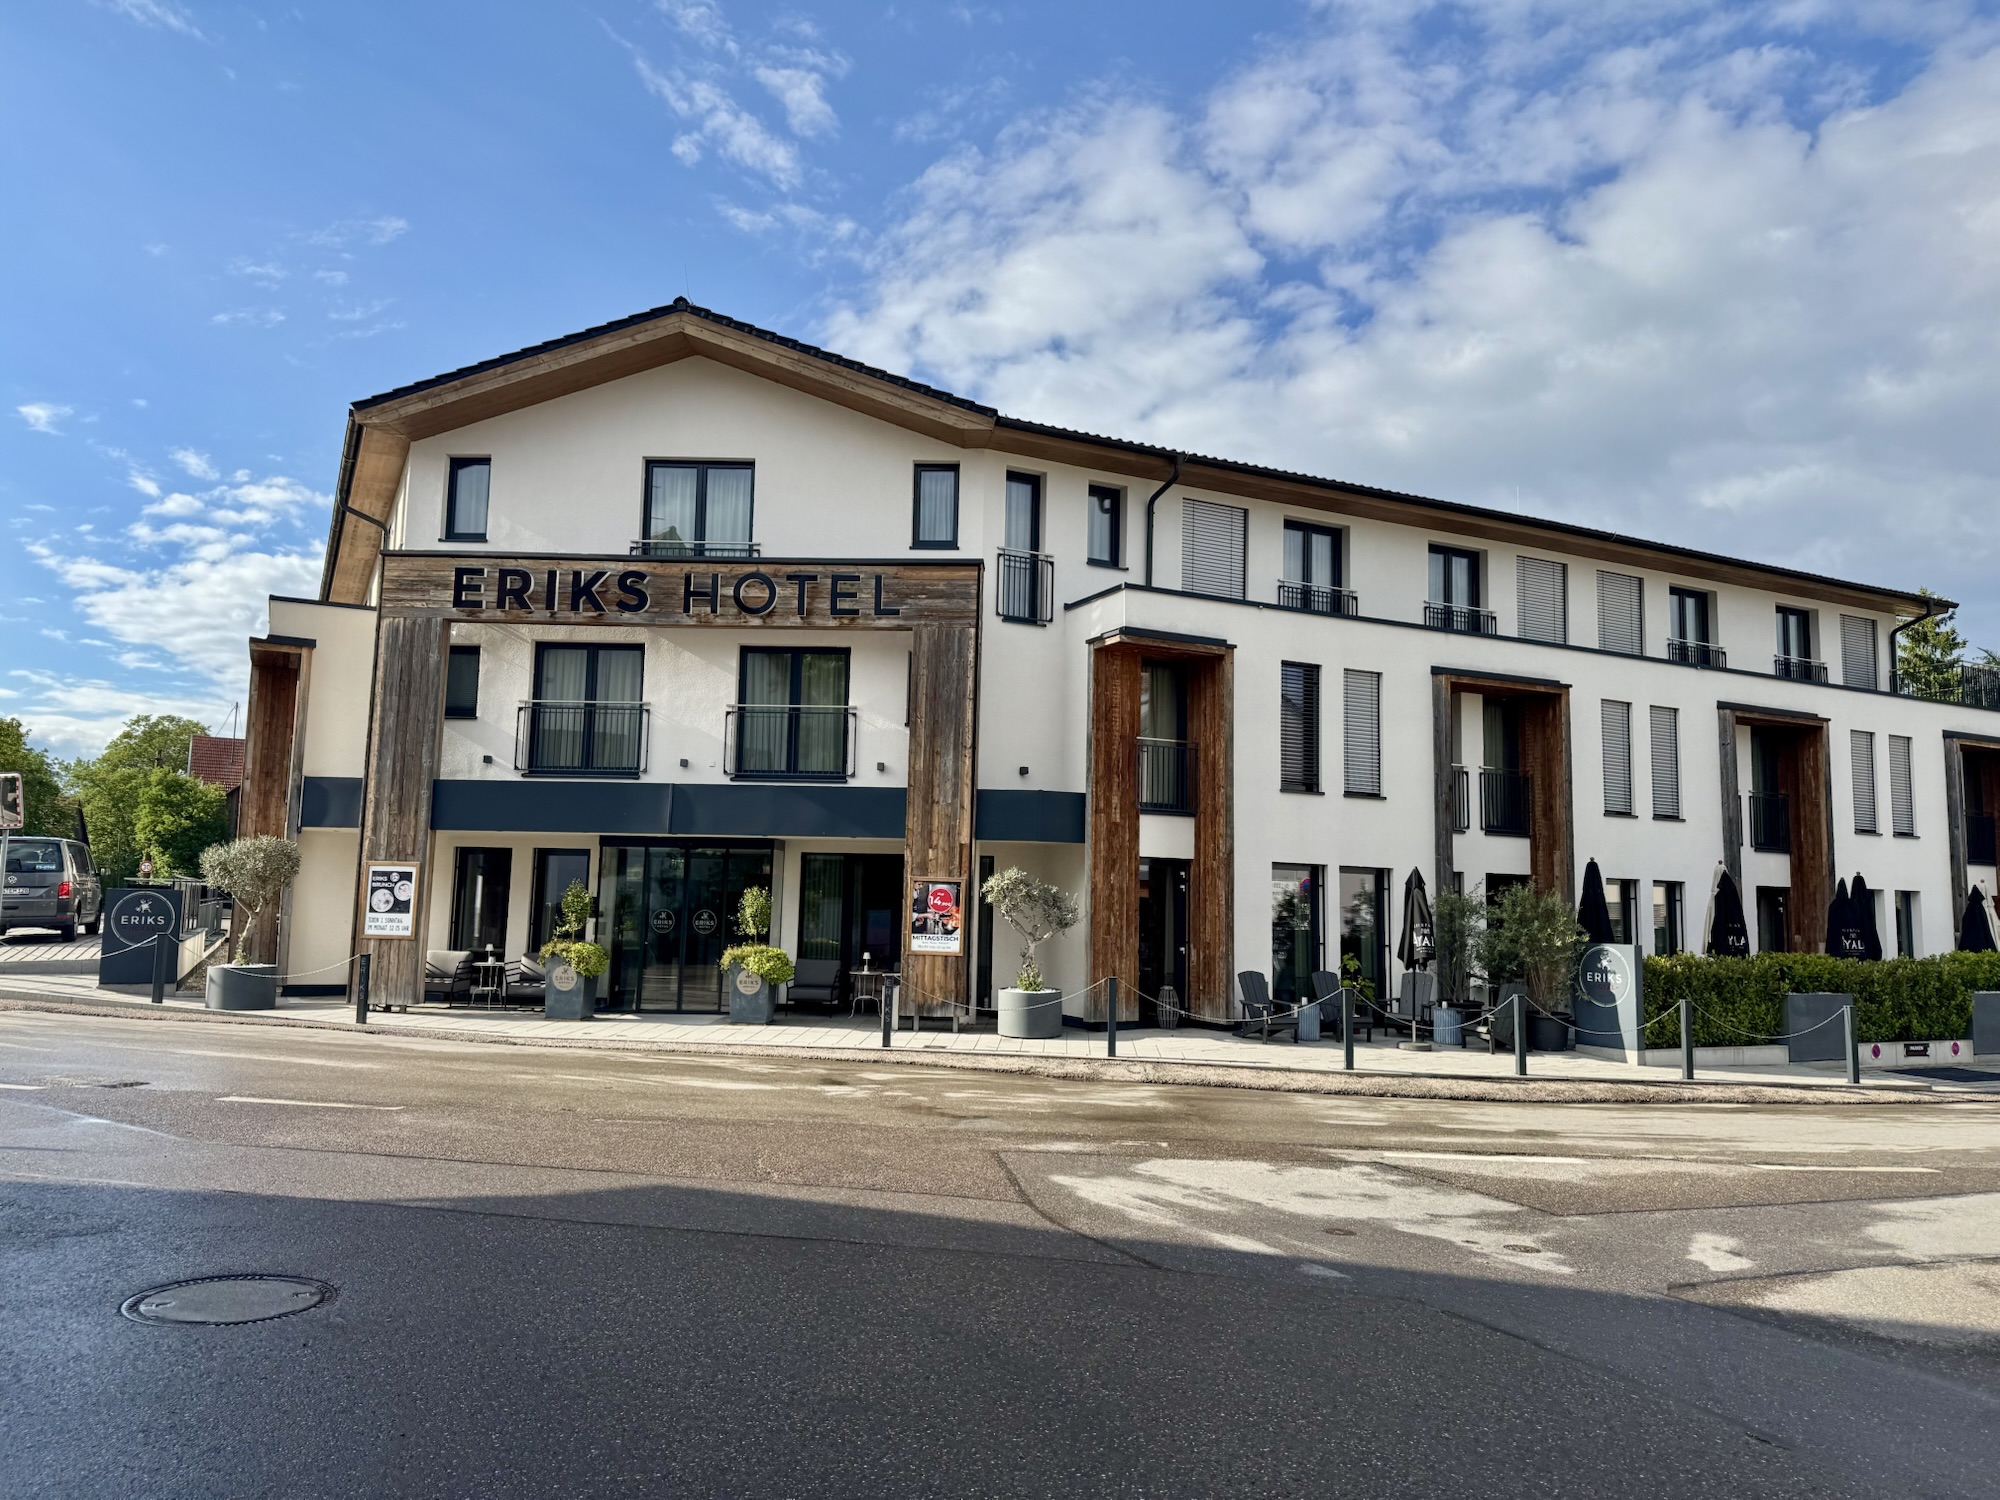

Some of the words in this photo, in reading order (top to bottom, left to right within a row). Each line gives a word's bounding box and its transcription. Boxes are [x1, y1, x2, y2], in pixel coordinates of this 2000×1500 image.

[452, 567, 650, 614] ERIKS
[682, 572, 902, 617] HOTEL
[121, 915, 165, 925] ERIKS
[1586, 971, 1623, 984] ERIKS
